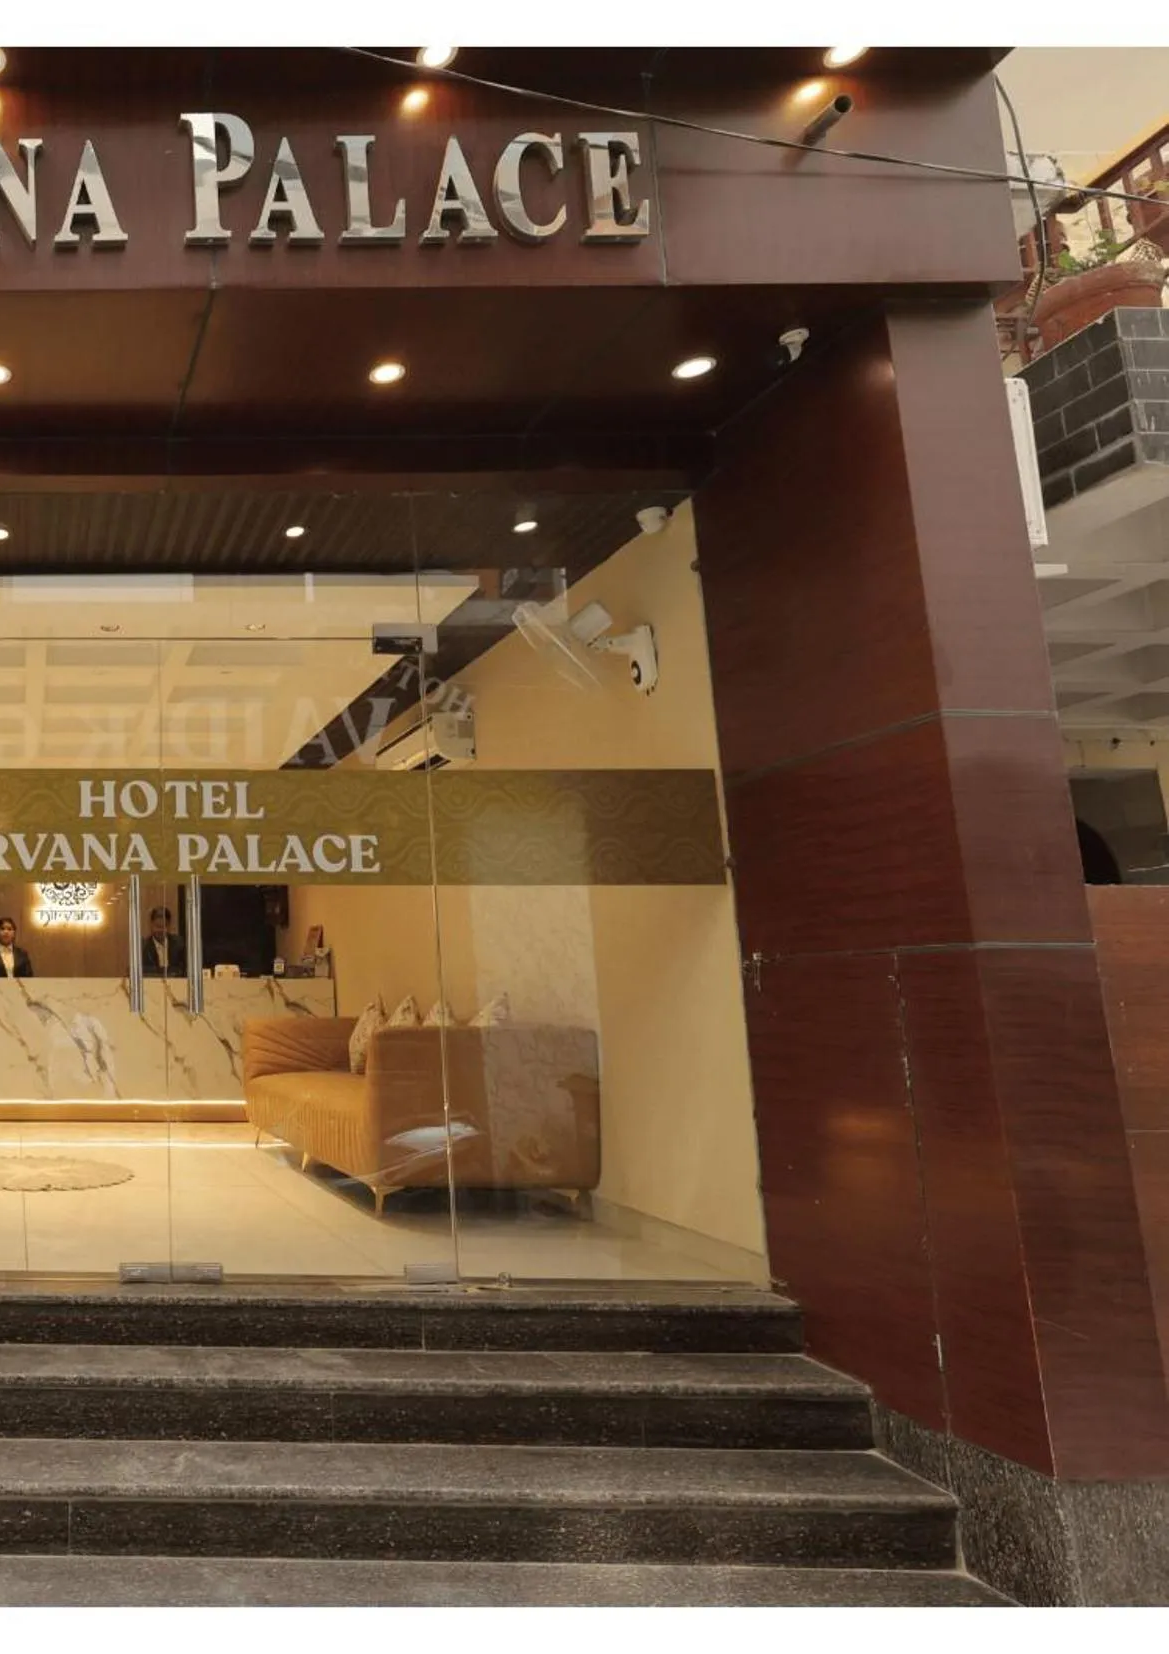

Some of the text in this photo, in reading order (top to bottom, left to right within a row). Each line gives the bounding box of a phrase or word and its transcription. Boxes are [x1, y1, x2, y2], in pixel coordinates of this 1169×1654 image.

[178, 111, 651, 247] PALACE
[78, 779, 265, 819] HOTEL
[176, 833, 381, 873] PALACE
